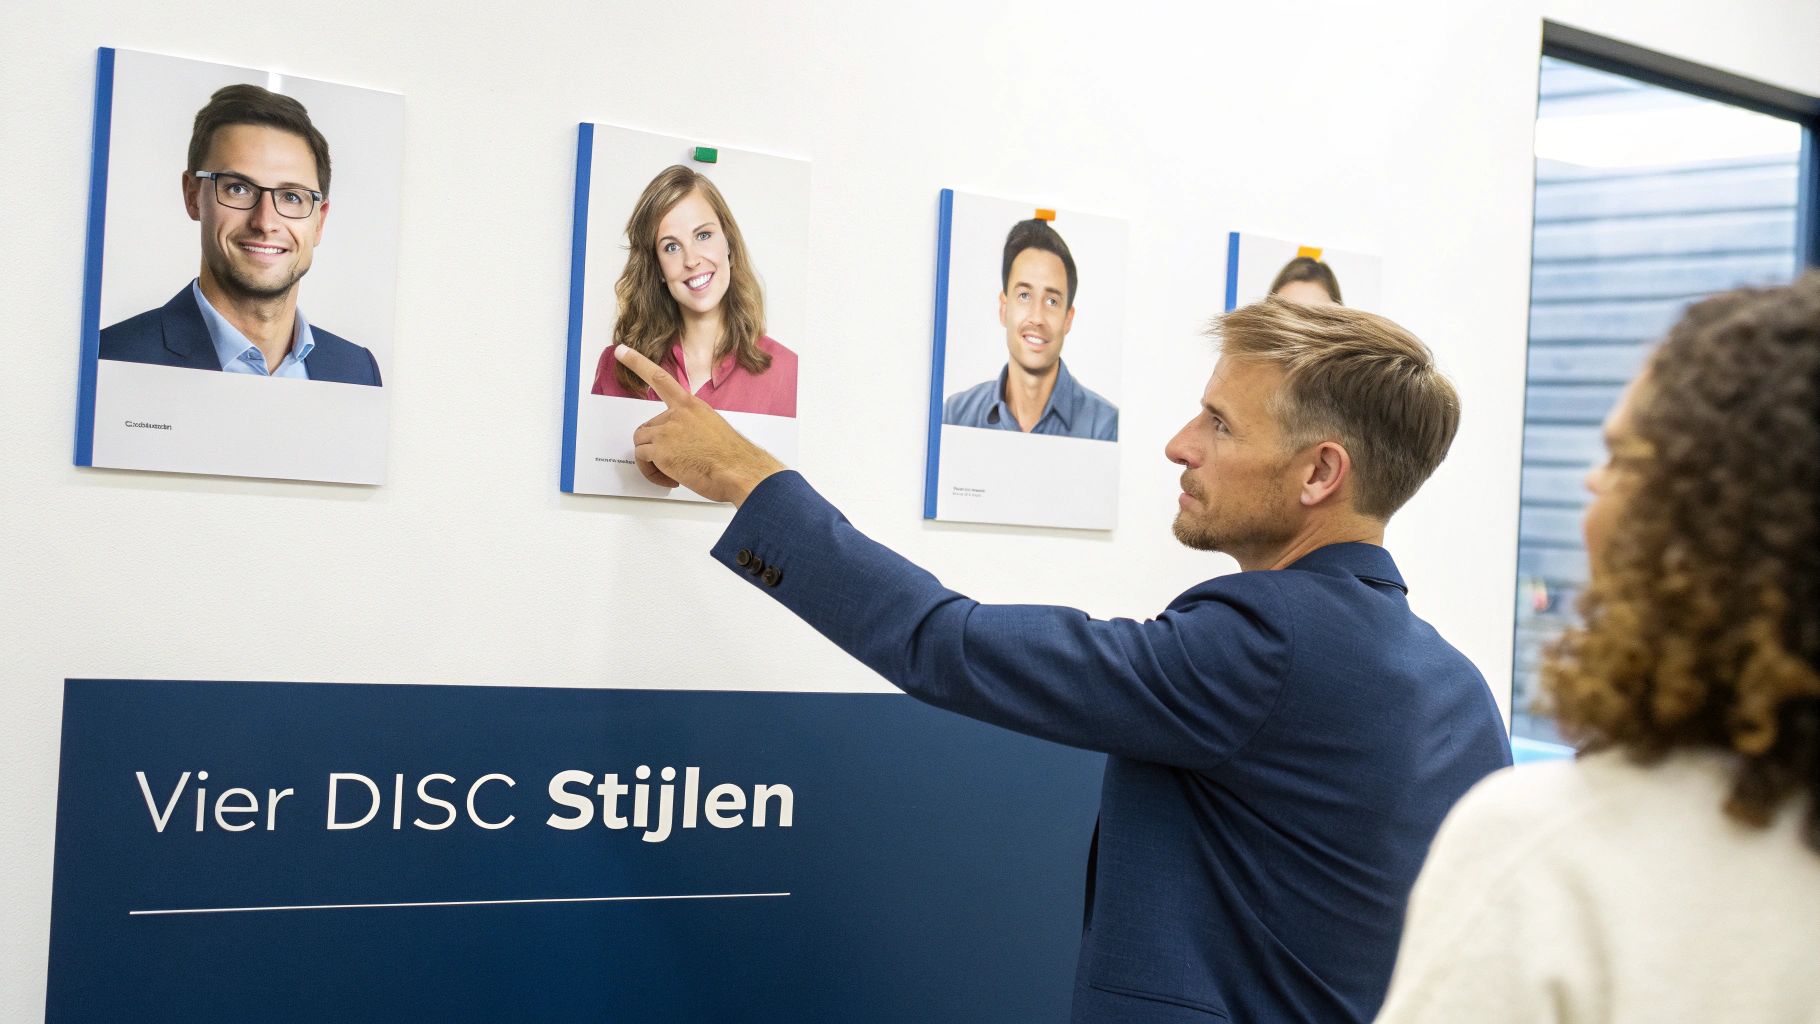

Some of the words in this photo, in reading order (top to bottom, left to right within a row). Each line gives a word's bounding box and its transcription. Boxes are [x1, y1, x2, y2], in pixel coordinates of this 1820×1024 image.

[136, 770, 294, 833] Vier
[326, 772, 517, 831] DISC
[546, 765, 794, 843] Stijlen
